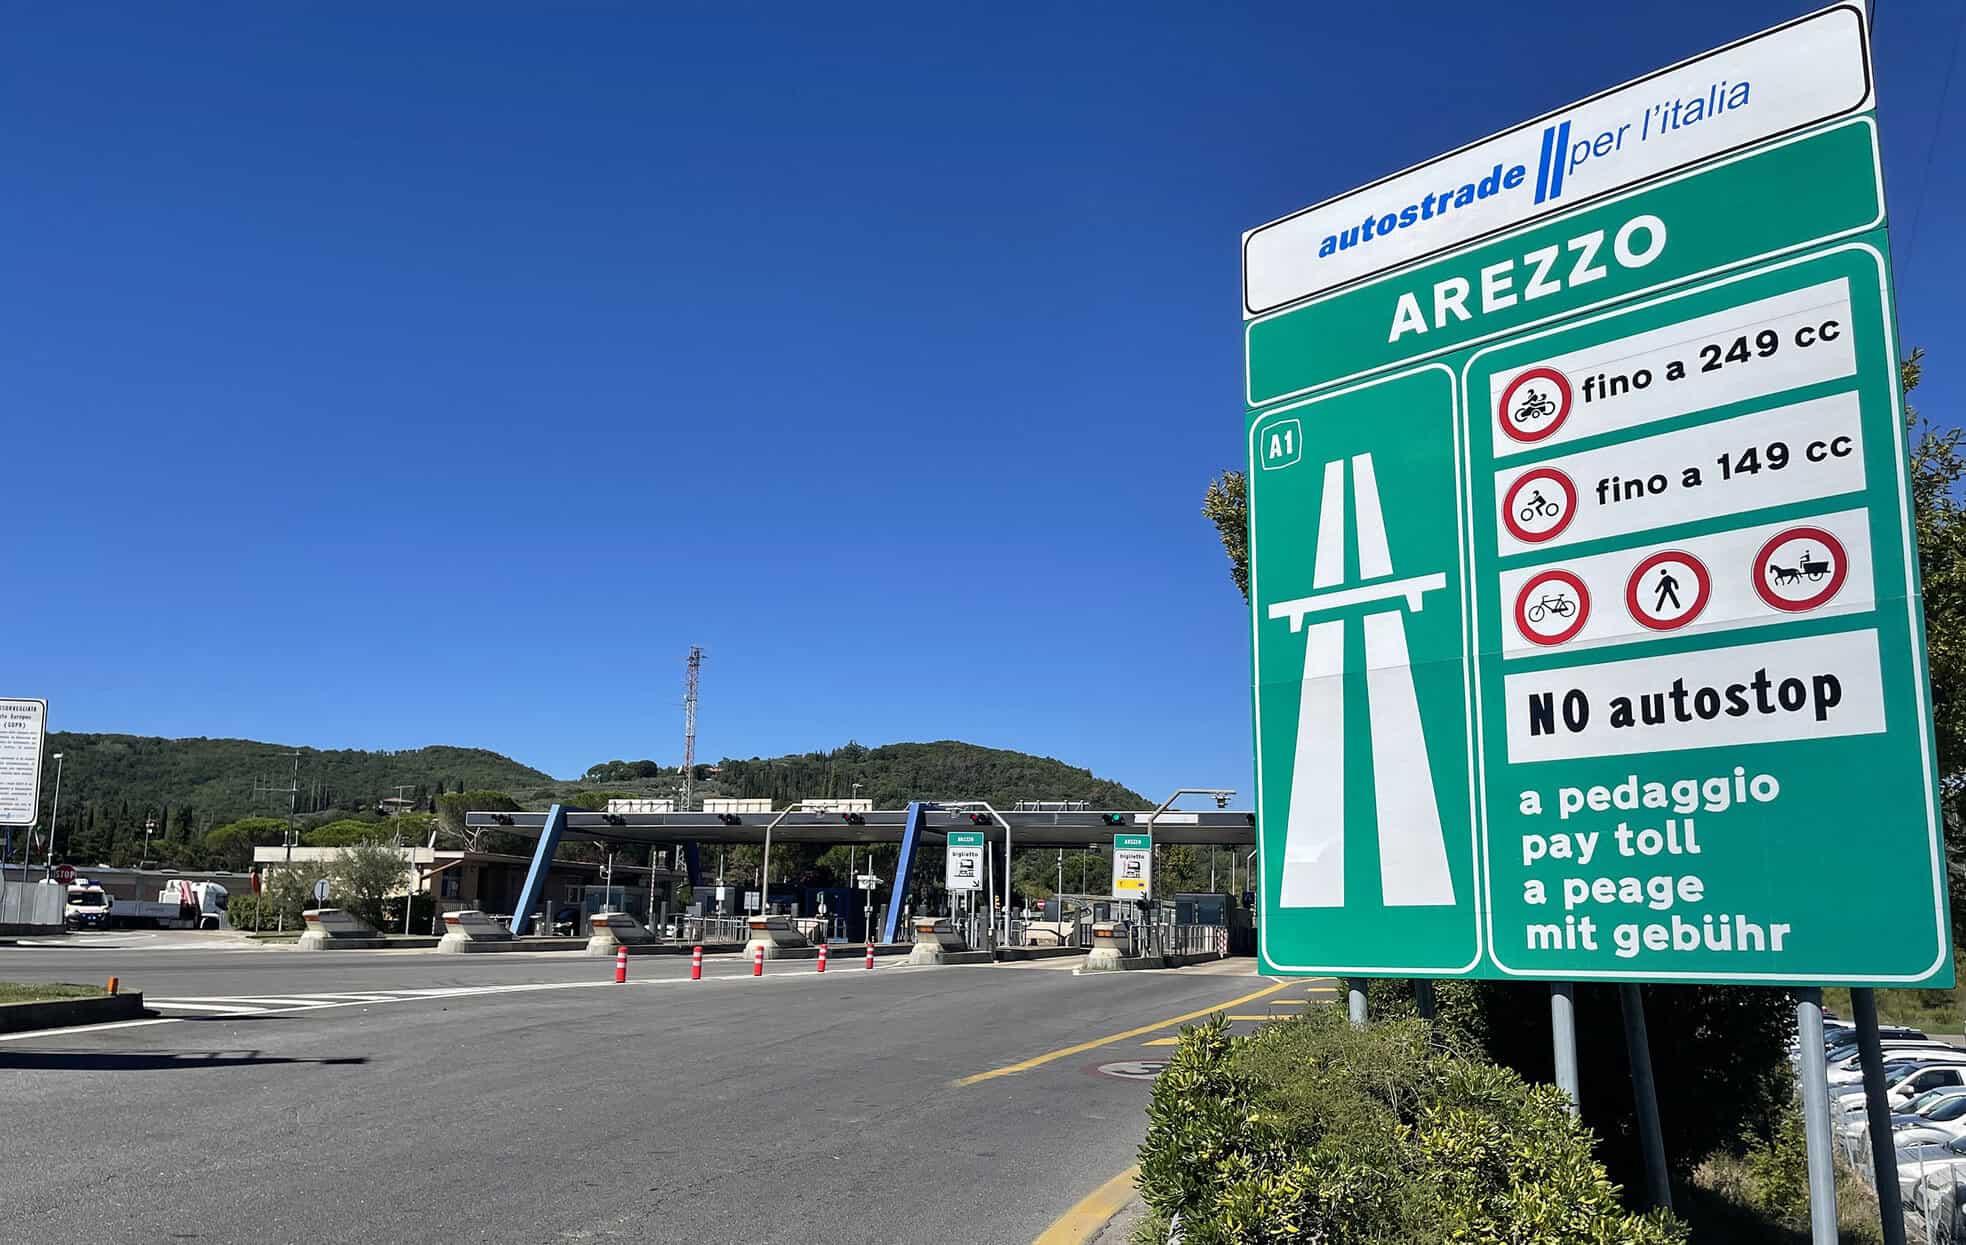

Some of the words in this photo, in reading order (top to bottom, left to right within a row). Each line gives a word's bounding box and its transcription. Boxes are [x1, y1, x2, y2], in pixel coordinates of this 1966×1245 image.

[1318, 164, 1527, 258] autostrade
[1568, 123, 1632, 176] per
[1388, 214, 1668, 344] AREZZO
[1581, 369, 1652, 403] fino
[1666, 360, 1686, 381] a
[1699, 329, 1779, 373] 249
[1794, 320, 1842, 348] cc
[1268, 430, 1294, 460] A1
[1595, 472, 1668, 506] fino
[1682, 467, 1702, 488] a
[1717, 441, 1790, 481] 149
[1806, 436, 1854, 463] cc
[1528, 688, 1590, 737] NO
[1609, 667, 1843, 730] autostop
[1519, 790, 1543, 816] a
[1558, 766, 1780, 820] pedaggio
[1522, 831, 1600, 866] pay
[1614, 818, 1701, 857] toll
[55, 870, 75, 879] STOP
[1523, 879, 1547, 905] a
[1563, 876, 1704, 911] peage
[1526, 914, 1598, 951] mit
[1613, 913, 1791, 959] gebühr
